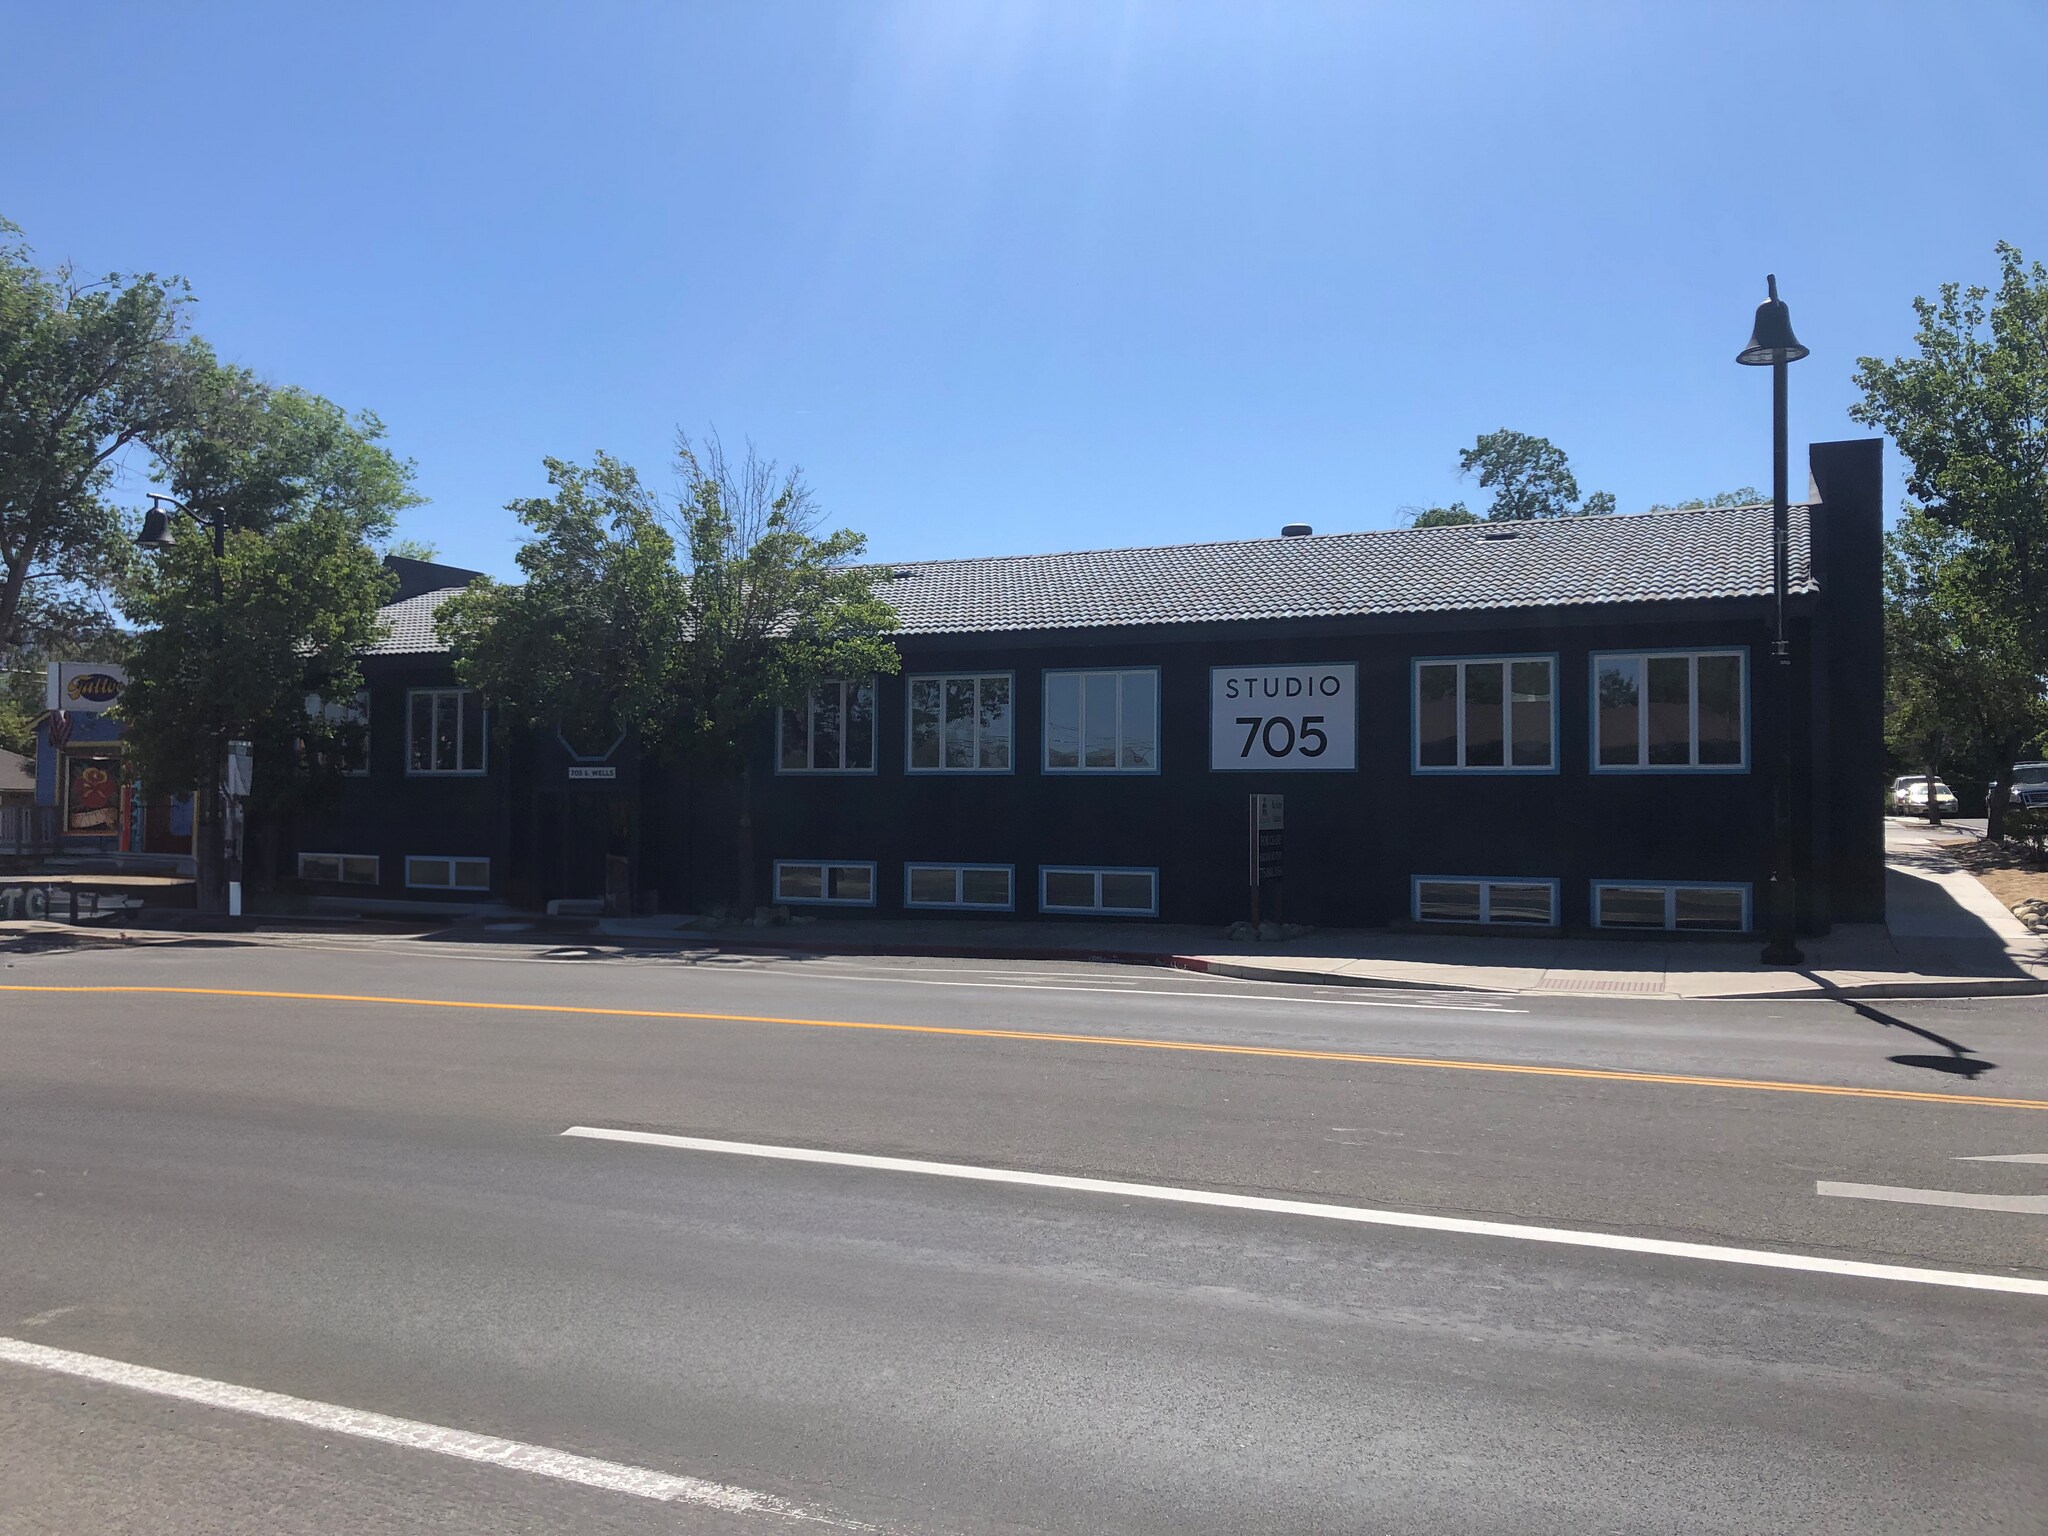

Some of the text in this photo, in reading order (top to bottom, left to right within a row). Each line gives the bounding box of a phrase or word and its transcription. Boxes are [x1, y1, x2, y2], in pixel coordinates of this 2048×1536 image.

[1225, 675, 1341, 699] STUDIO
[1235, 716, 1328, 758] 705
[592, 769, 614, 777] WELLS
